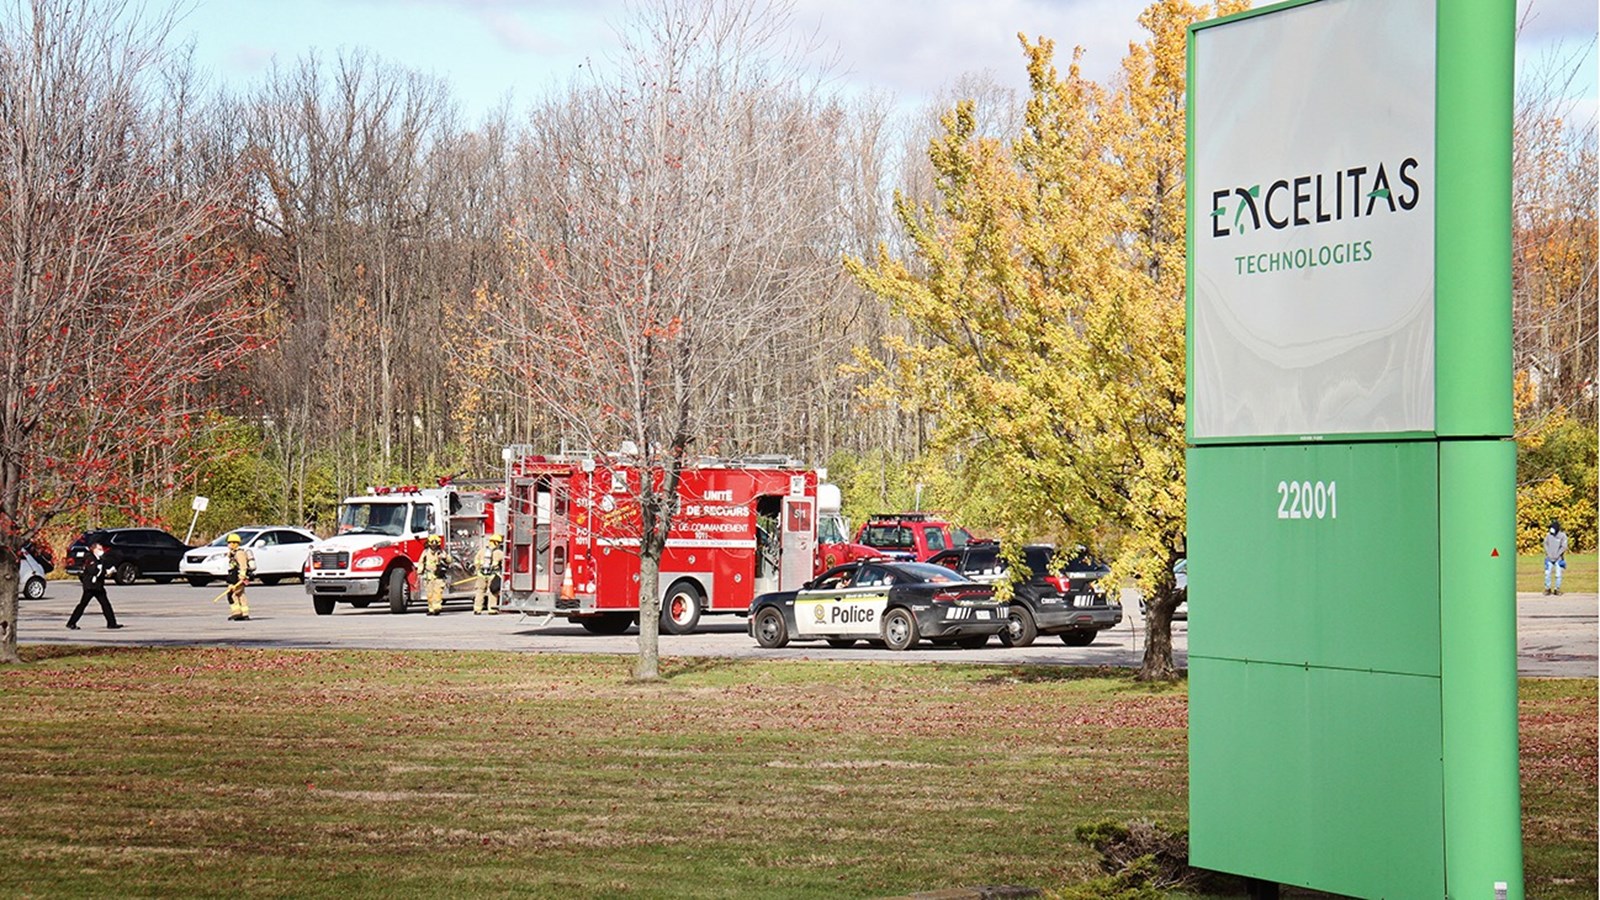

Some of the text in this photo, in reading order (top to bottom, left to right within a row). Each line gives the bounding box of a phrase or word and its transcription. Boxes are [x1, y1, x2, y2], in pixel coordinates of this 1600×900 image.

[1210, 158, 1420, 238] EXCELITAS
[1235, 241, 1373, 275] TECHNOLOGIES
[686, 505, 750, 517] DE SECOURS
[1277, 481, 1337, 519] 22001
[691, 523, 749, 532] COMMANDEMENT
[831, 605, 874, 624] Police
